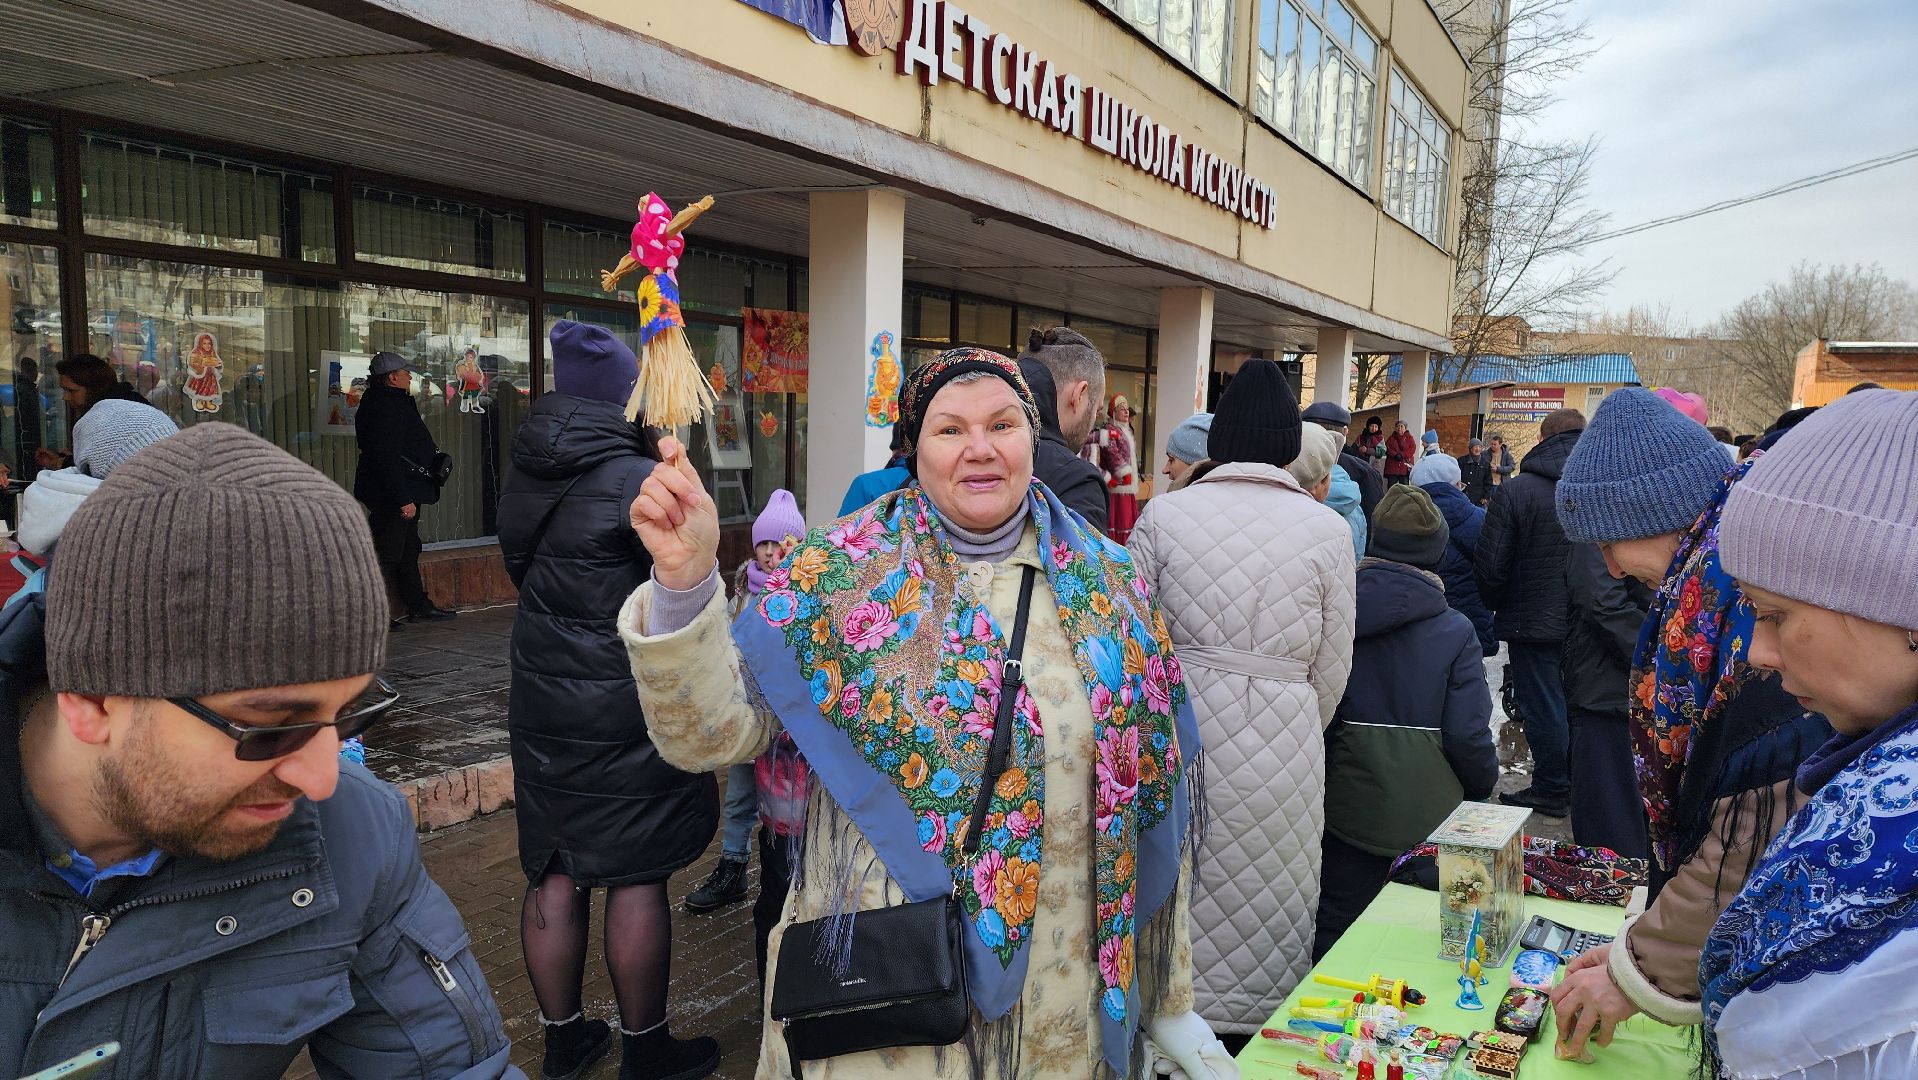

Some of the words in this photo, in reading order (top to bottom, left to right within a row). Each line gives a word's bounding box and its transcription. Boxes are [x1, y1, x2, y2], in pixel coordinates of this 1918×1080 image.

[900, 0, 1081, 140] ДЕТСКАЯ
[1088, 87, 1186, 190] ШКОЛА
[1190, 147, 1279, 231] ИСКУССТВ
[1513, 389, 1540, 398] ШКОЛА
[1491, 401, 1533, 410] ОСТРАННЫХ
[1533, 401, 1562, 410] ЯЗЫКОВ
